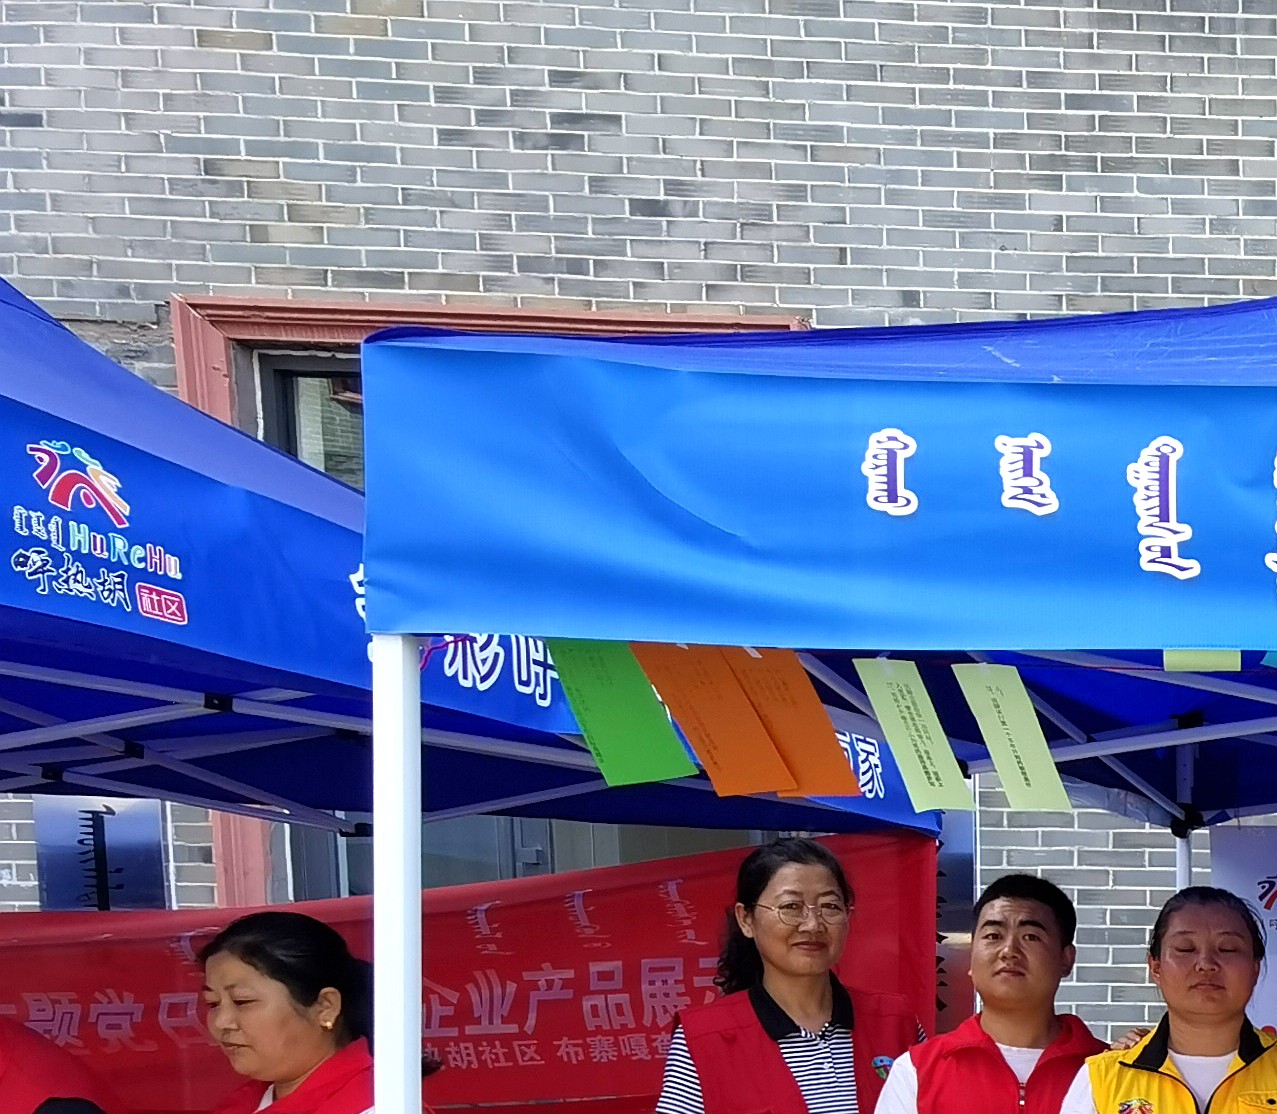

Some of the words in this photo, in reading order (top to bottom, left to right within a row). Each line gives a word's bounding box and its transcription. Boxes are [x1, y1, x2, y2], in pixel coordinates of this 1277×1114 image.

[68, 520, 182, 579] HuReHu
[11, 548, 131, 611] 呼热胡
[138, 585, 187, 624] 社区
